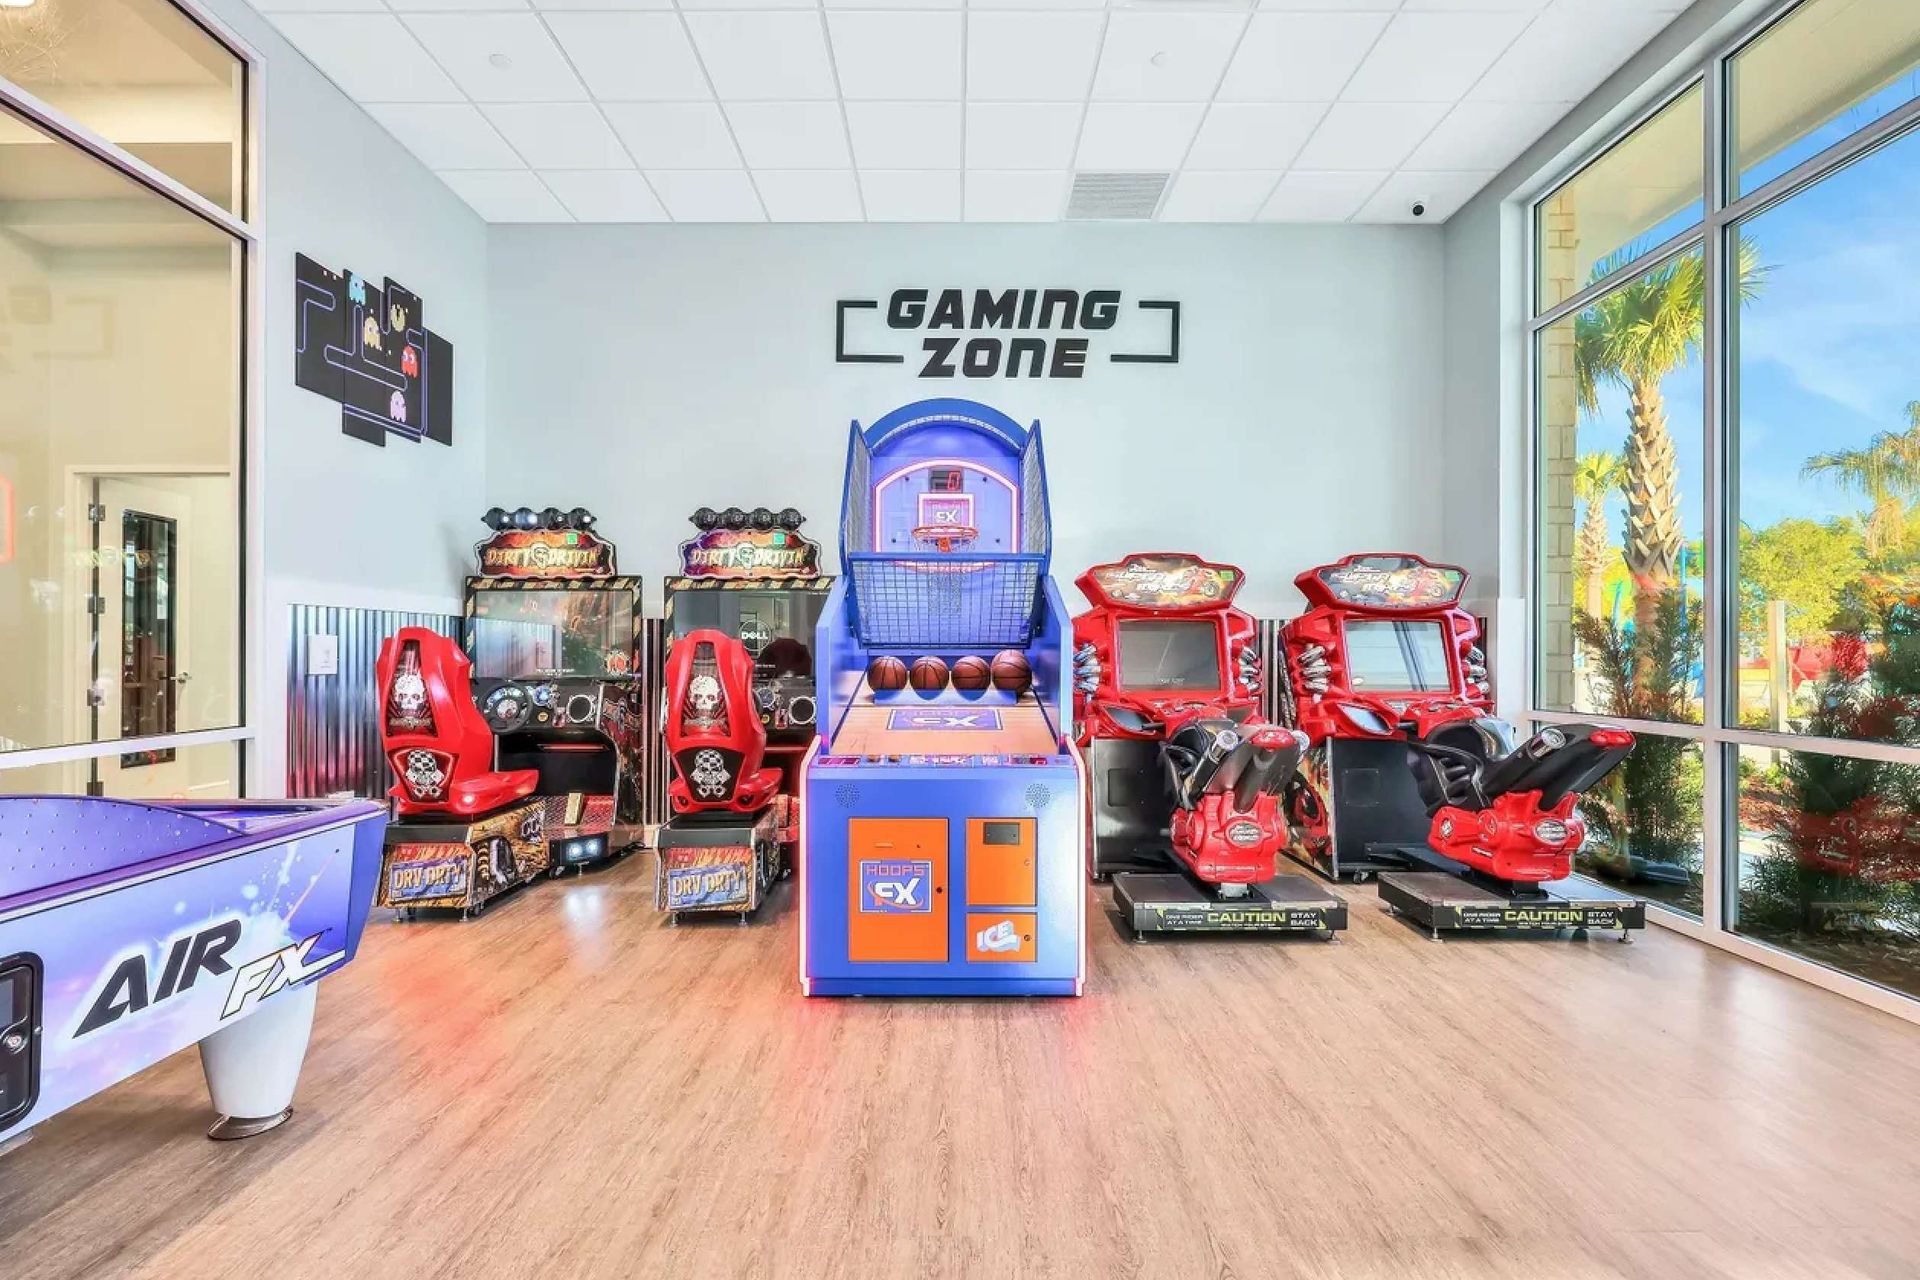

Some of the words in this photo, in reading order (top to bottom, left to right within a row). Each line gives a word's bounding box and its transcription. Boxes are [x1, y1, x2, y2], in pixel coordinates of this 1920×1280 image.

[886, 288, 1122, 330] GAMING
[917, 337, 1090, 378] ZONE
[487, 547, 533, 567] DIRTY
[690, 547, 737, 567] DIRTY
[741, 631, 769, 640] DELL
[394, 866, 424, 889] DRV
[866, 865, 925, 876] HOOPS
[672, 873, 702, 896] DRV
[1207, 911, 1286, 923] CAUTION
[1504, 911, 1583, 922] CAUTION
[976, 920, 1020, 952] ICE
[72, 919, 242, 1039] AIR
[219, 930, 346, 1021] FX
